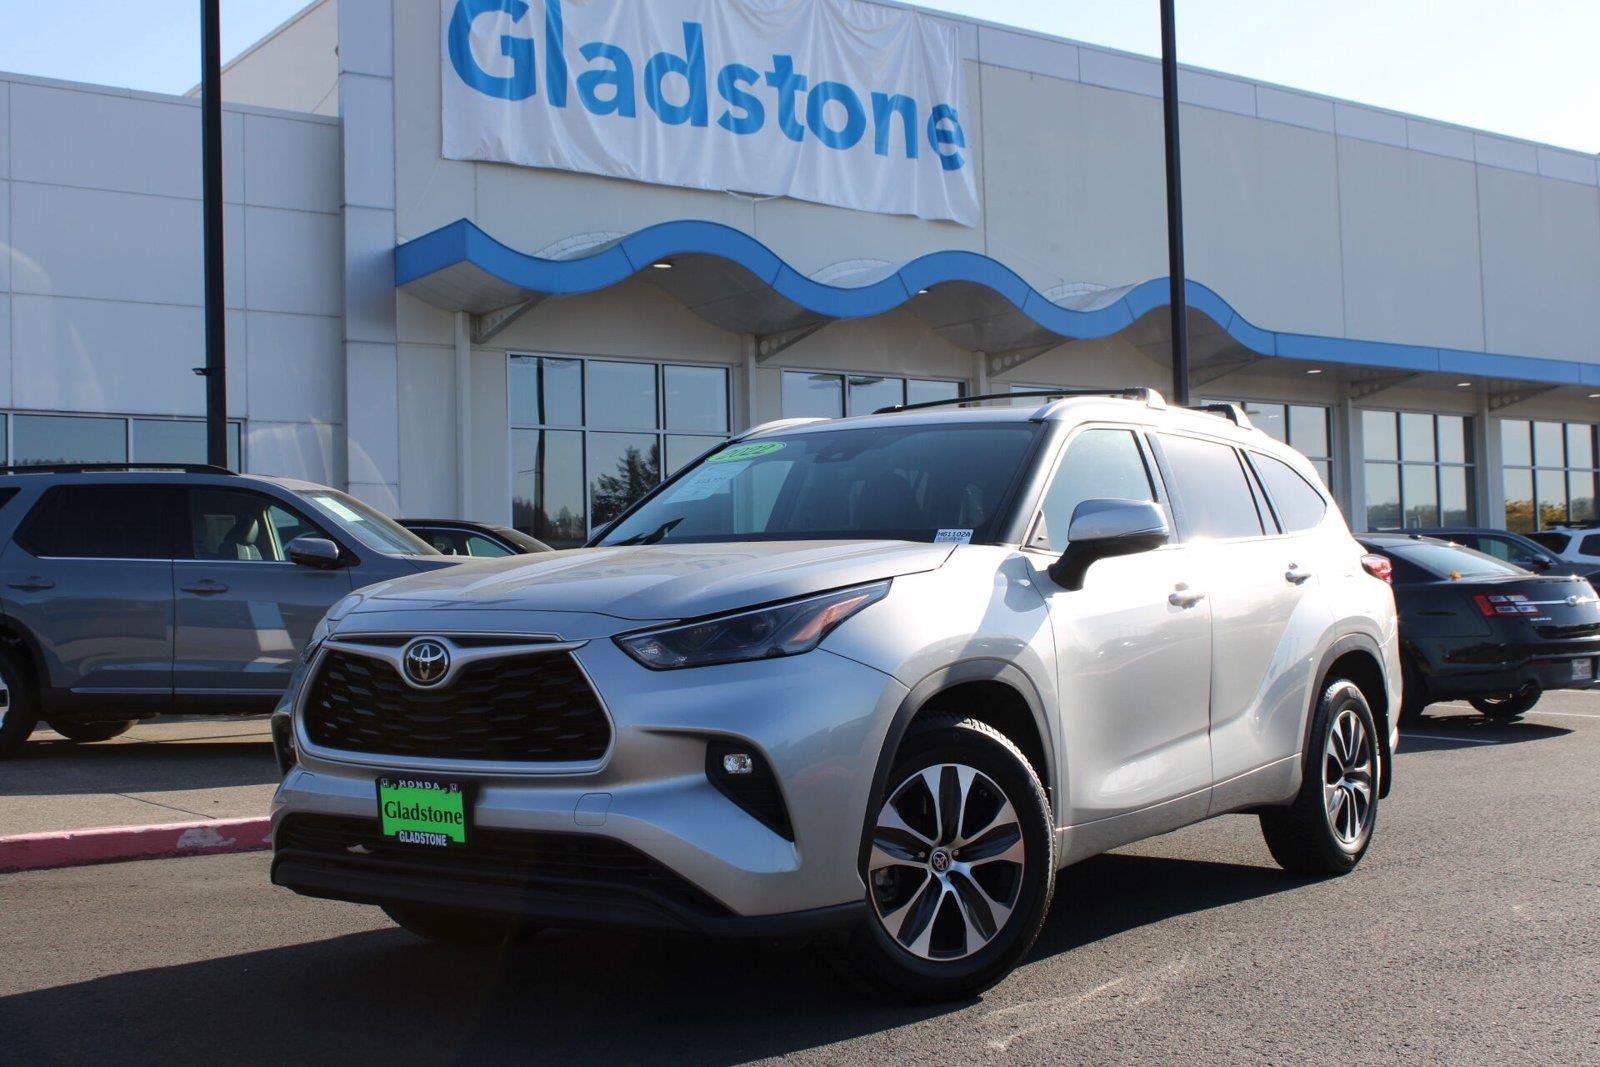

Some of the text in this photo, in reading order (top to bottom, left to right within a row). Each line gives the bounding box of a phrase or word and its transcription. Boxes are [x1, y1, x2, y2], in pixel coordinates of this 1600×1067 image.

[447, 0, 966, 171] Gladstone
[399, 780, 440, 790] HONDA
[384, 801, 463, 825] Gladstone
[399, 831, 447, 846] GLADSTONE
